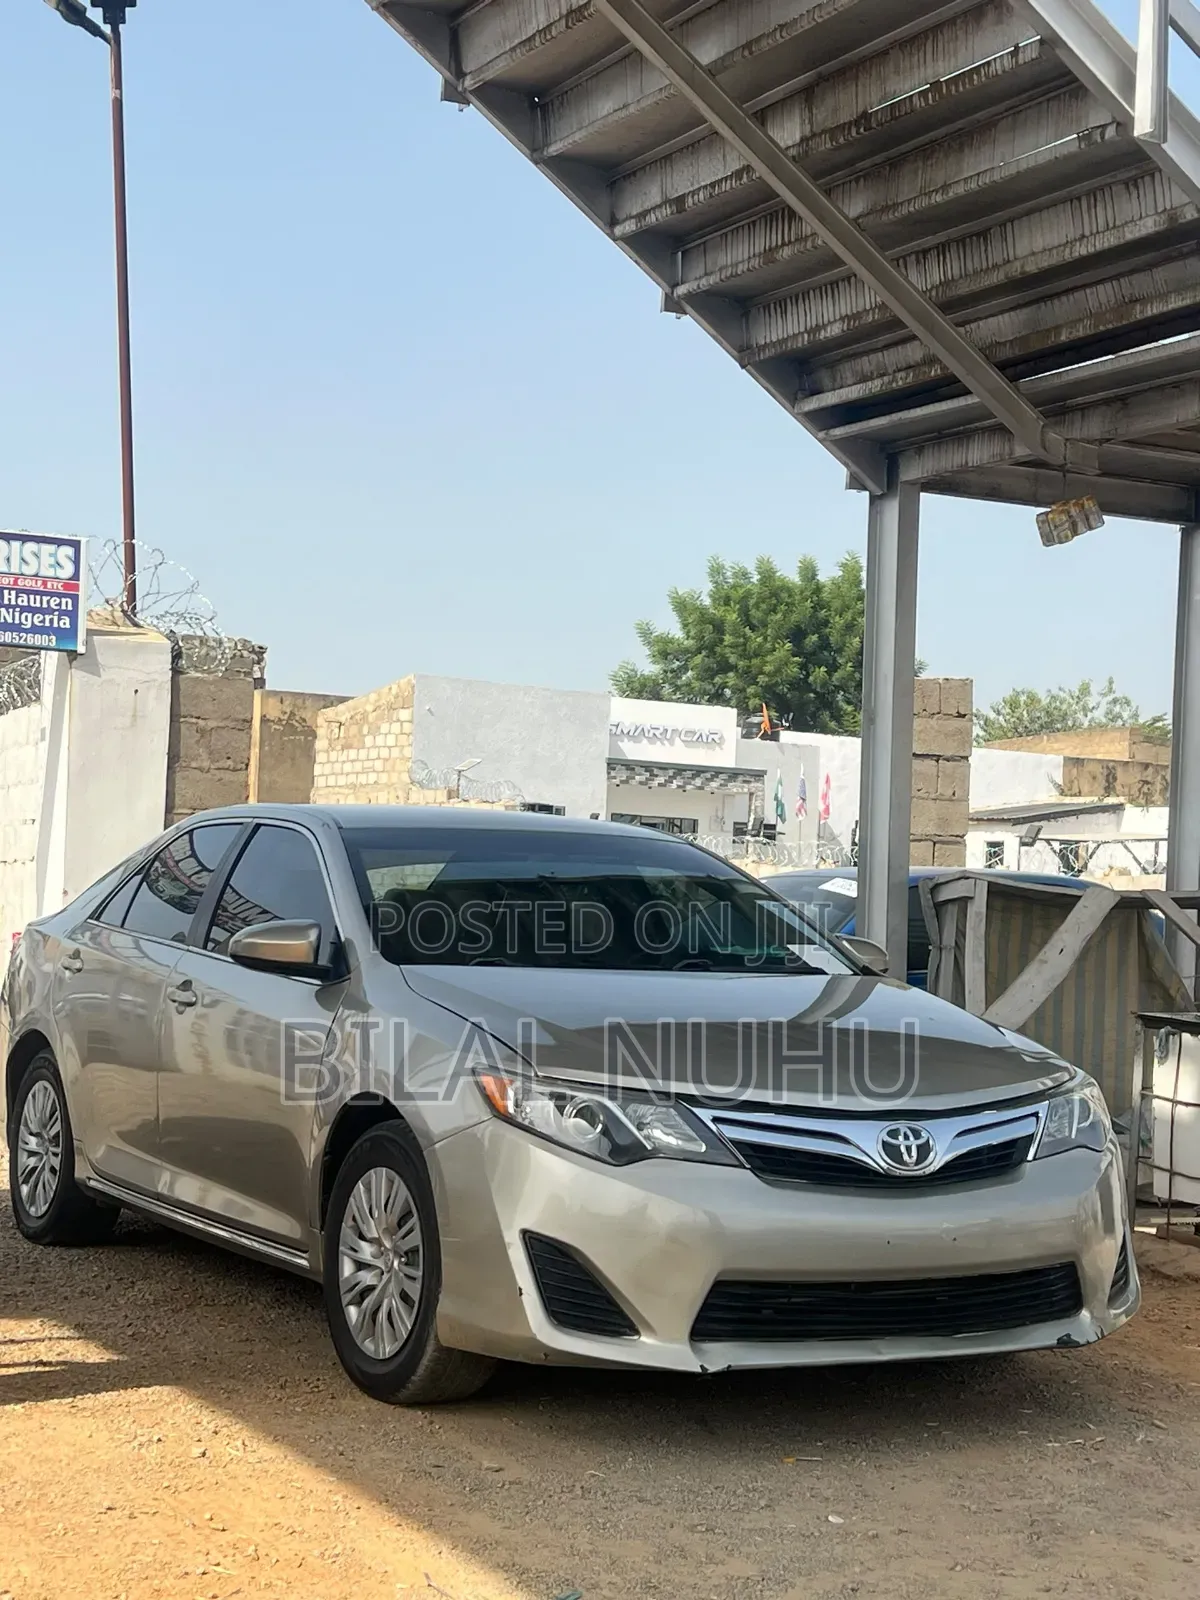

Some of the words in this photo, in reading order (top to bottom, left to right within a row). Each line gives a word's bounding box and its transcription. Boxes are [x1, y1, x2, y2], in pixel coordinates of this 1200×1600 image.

[18, 579, 44, 589] GOLF,
[47, 582, 64, 590] ETC
[3, 589, 73, 610] Hauren
[0, 608, 71, 628] Nigeria
[679, 728, 722, 743] CAR
